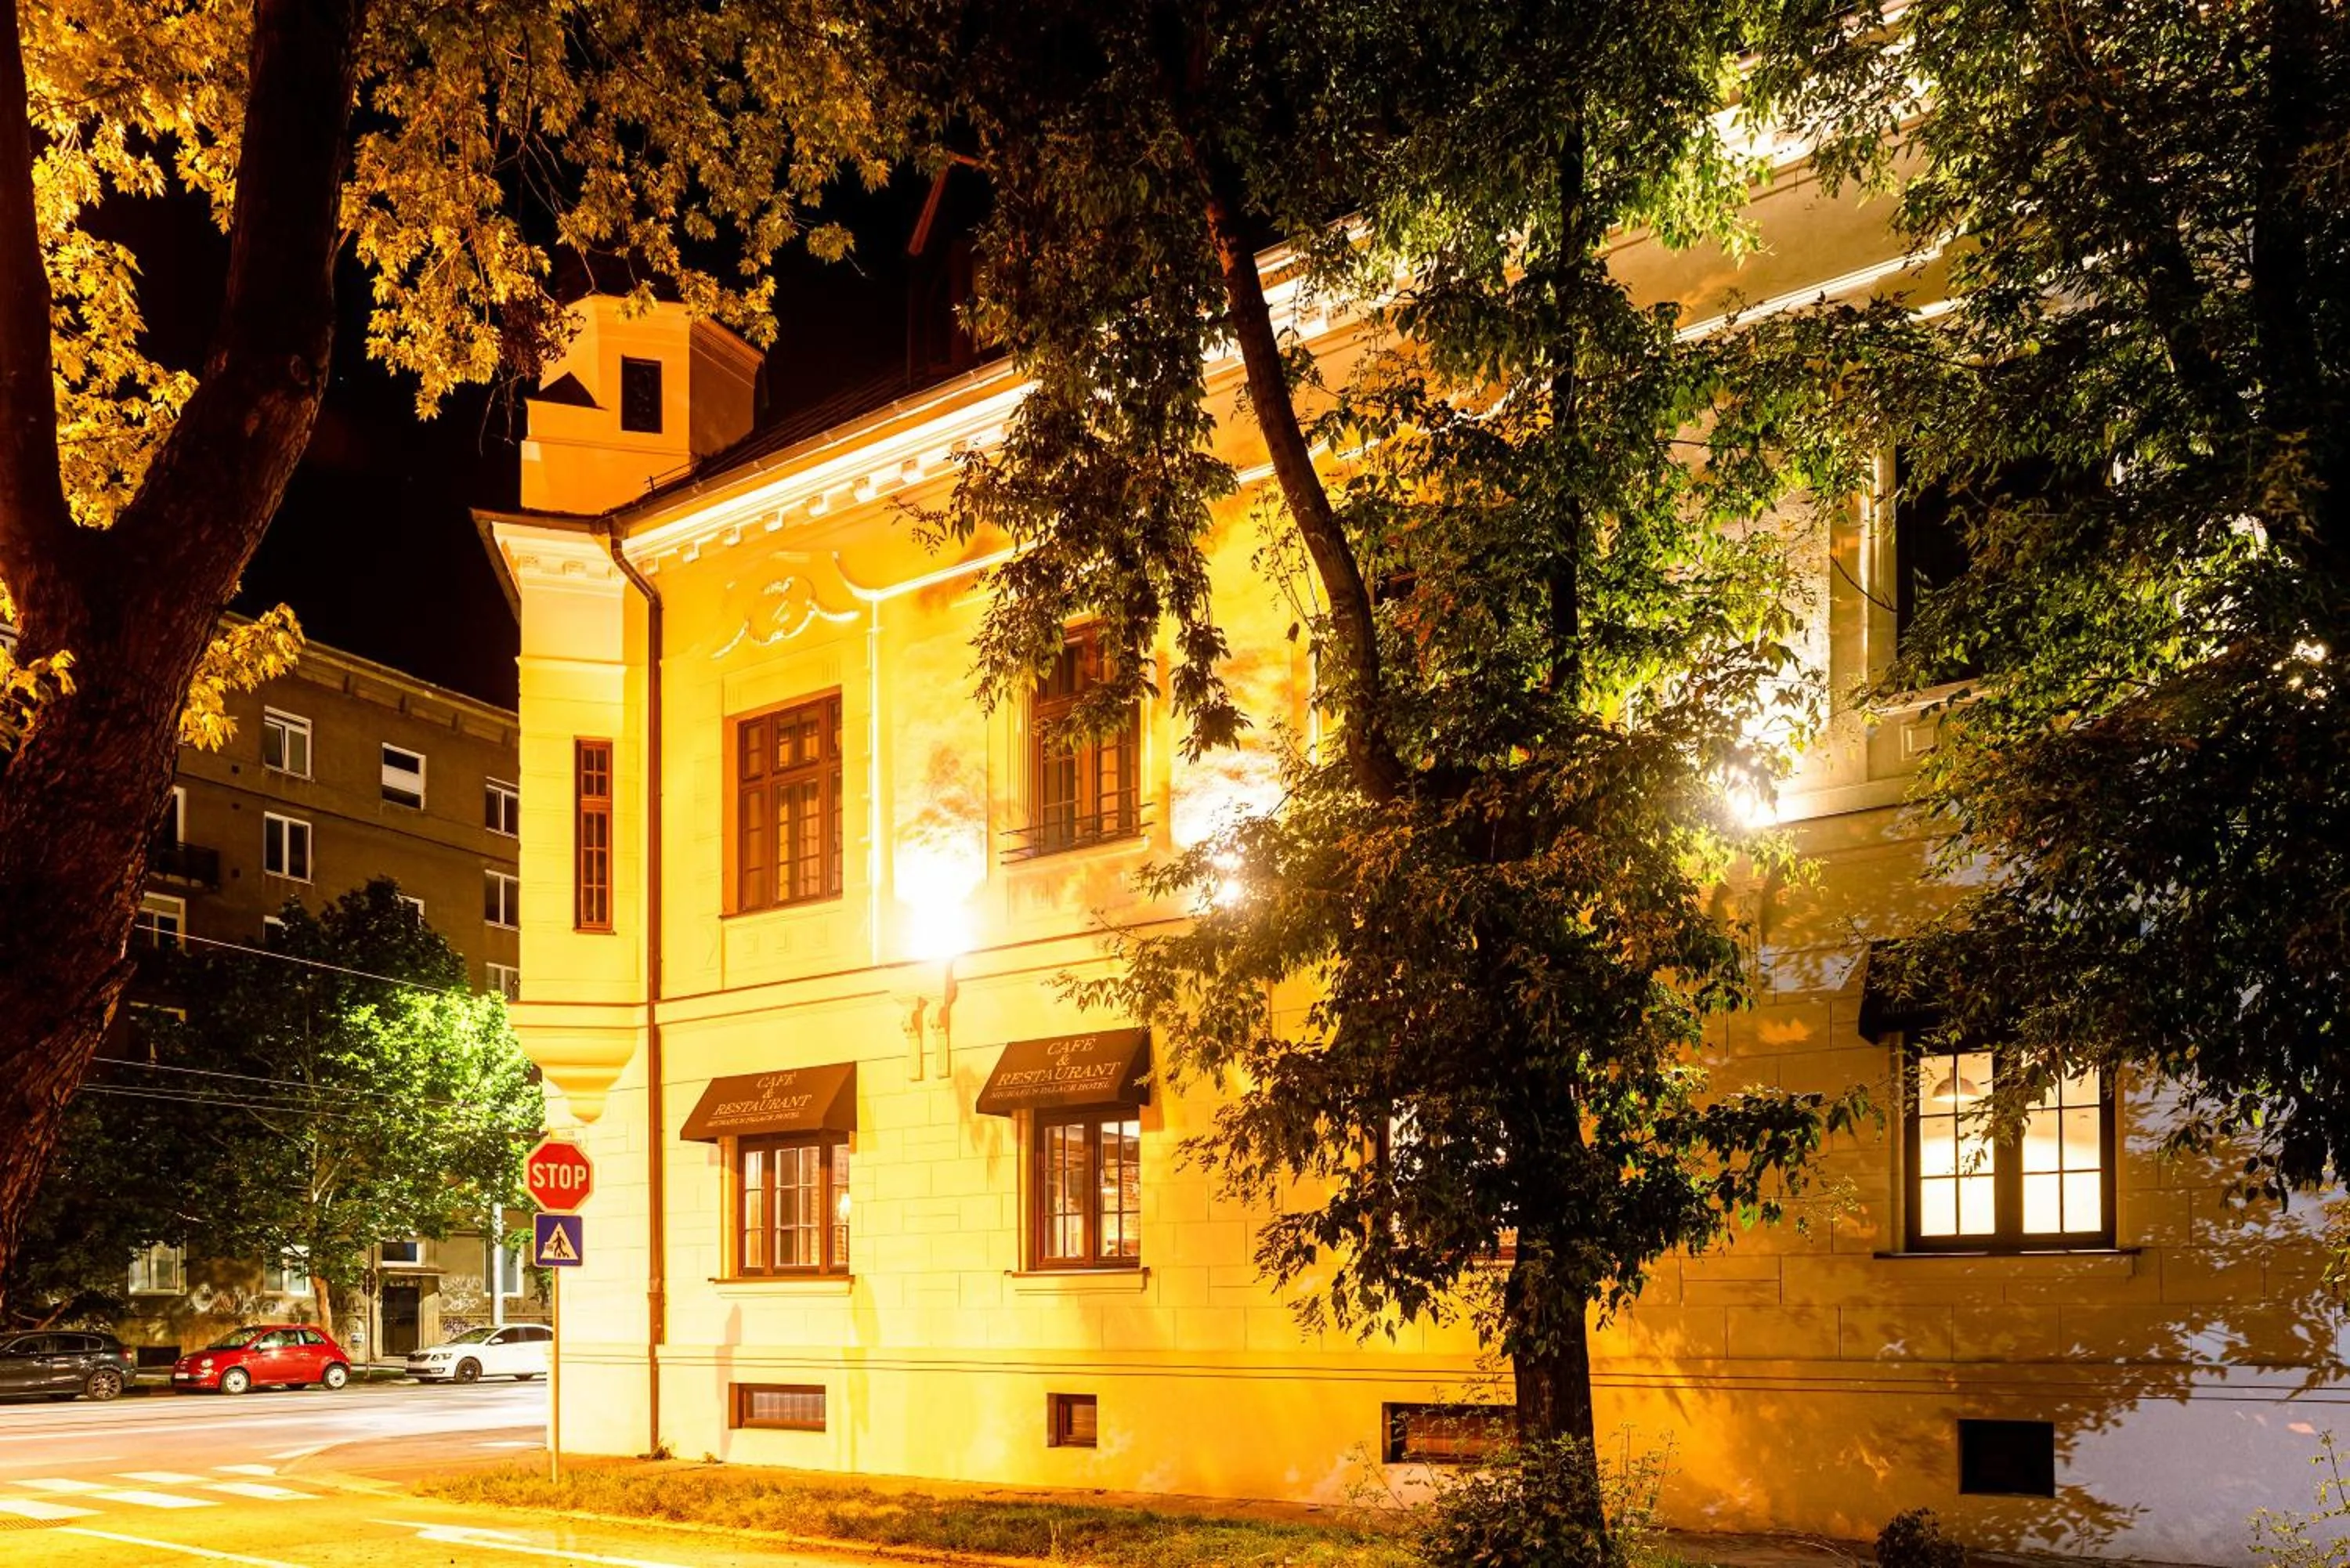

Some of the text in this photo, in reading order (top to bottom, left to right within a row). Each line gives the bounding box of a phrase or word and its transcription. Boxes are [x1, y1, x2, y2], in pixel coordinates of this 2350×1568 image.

[1056, 1053, 1071, 1066] &
[996, 1061, 1121, 1086] RESTAURANT
[712, 1093, 812, 1116] RESTAURANT
[762, 1087, 776, 1099] &
[532, 1162, 587, 1190] STOP
